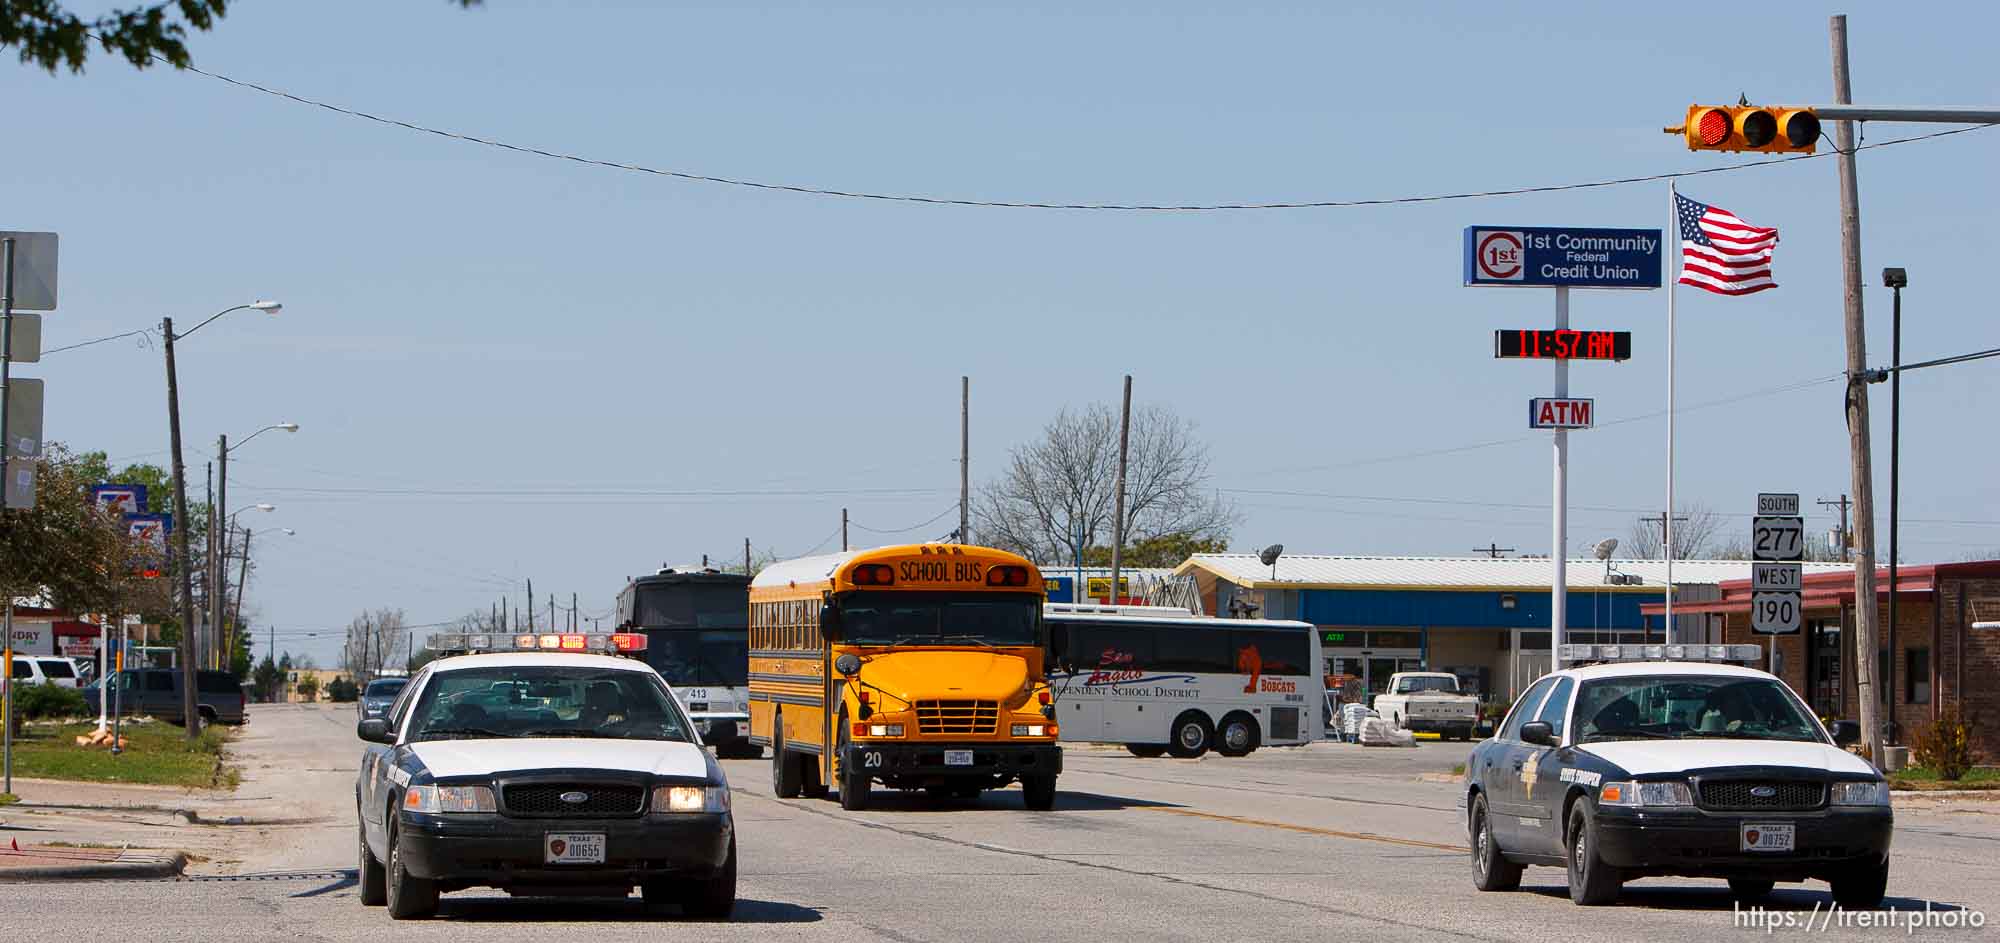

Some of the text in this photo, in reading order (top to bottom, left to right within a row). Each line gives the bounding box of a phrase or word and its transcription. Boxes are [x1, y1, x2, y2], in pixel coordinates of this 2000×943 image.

[1525, 234, 1657, 254] 1st Community
[1489, 248, 1518, 266] 1st
[1566, 252, 1609, 262] Federal
[1541, 264, 1639, 279] Credit Union
[1519, 330, 1615, 358] 11:57 AM
[1538, 402, 1590, 424] ATM
[1760, 498, 1796, 511] SOUTH
[1756, 528, 1799, 550] 277
[900, 561, 982, 582] SCHOOL BUS
[1758, 568, 1796, 584] WEST
[1758, 601, 1793, 624] 190
[690, 689, 706, 698] 413
[864, 751, 882, 767] 20
[569, 844, 600, 857] 00655
